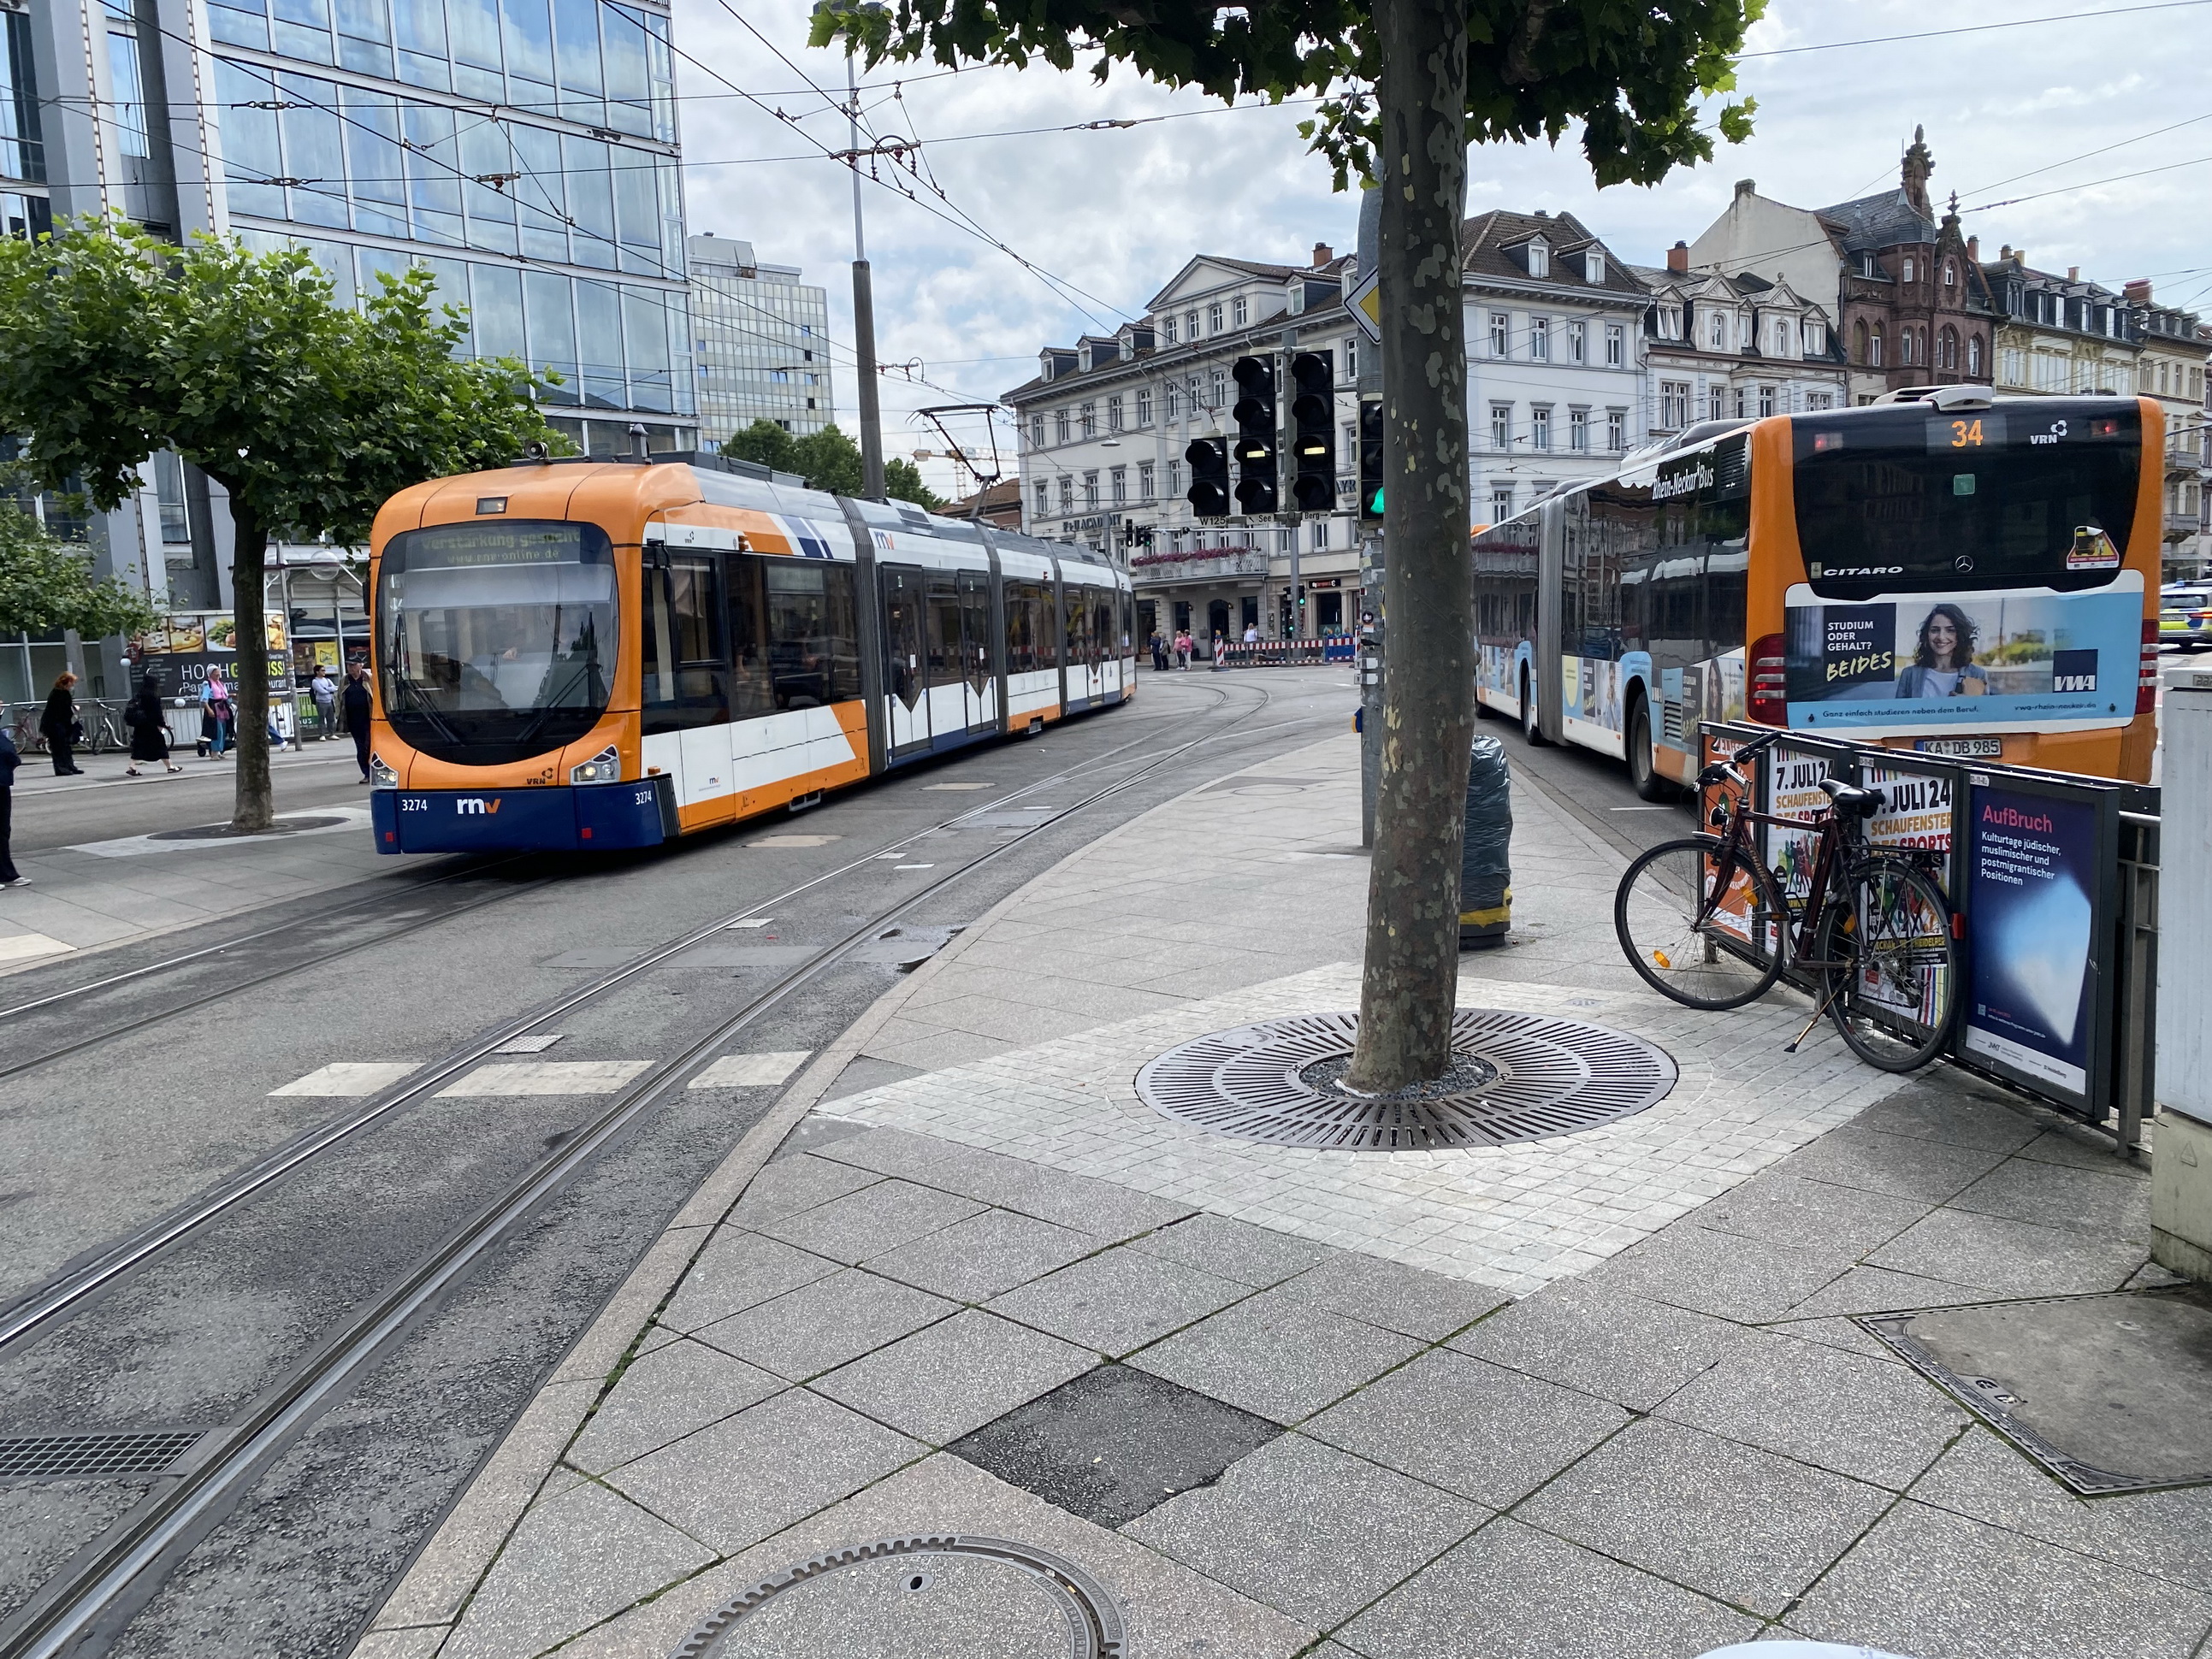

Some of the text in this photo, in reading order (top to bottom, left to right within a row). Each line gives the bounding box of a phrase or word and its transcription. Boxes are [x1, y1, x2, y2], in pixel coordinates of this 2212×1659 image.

[1951, 420, 1984, 447] 34
[2030, 434, 2057, 445] VRN
[1698, 464, 1714, 489] Bus
[1200, 517, 1226, 526] W125
[1258, 514, 1272, 523] See
[1823, 565, 1904, 577] CITARO
[1827, 620, 1874, 631] STUDIUM
[1827, 631, 1856, 641] ODER
[1826, 641, 1872, 652] GEHALT?
[1825, 651, 1892, 682] BEIDES
[2055, 675, 2096, 692] VWA
[1873, 708, 1911, 717] studieren
[1925, 740, 1999, 754] KA DB 985
[1776, 766, 1789, 791] 7.
[1790, 762, 1817, 789] JULI
[635, 790, 653, 805] 3274
[1776, 790, 1832, 809] SCHAUFENSTE
[1890, 782, 1925, 813] JULI
[1929, 778, 1951, 809] 24
[402, 799, 428, 812] 3274
[456, 798, 502, 815] rnv
[1871, 812, 1952, 837] SCHAUFENSTER
[1982, 805, 2053, 833] AufBruch
[1981, 830, 2061, 856] Kulturtage jüdischer,
[1981, 845, 2050, 865] muslimischer und
[1981, 858, 2055, 880] postmigrantischer
[1981, 868, 2024, 886] Positionen
